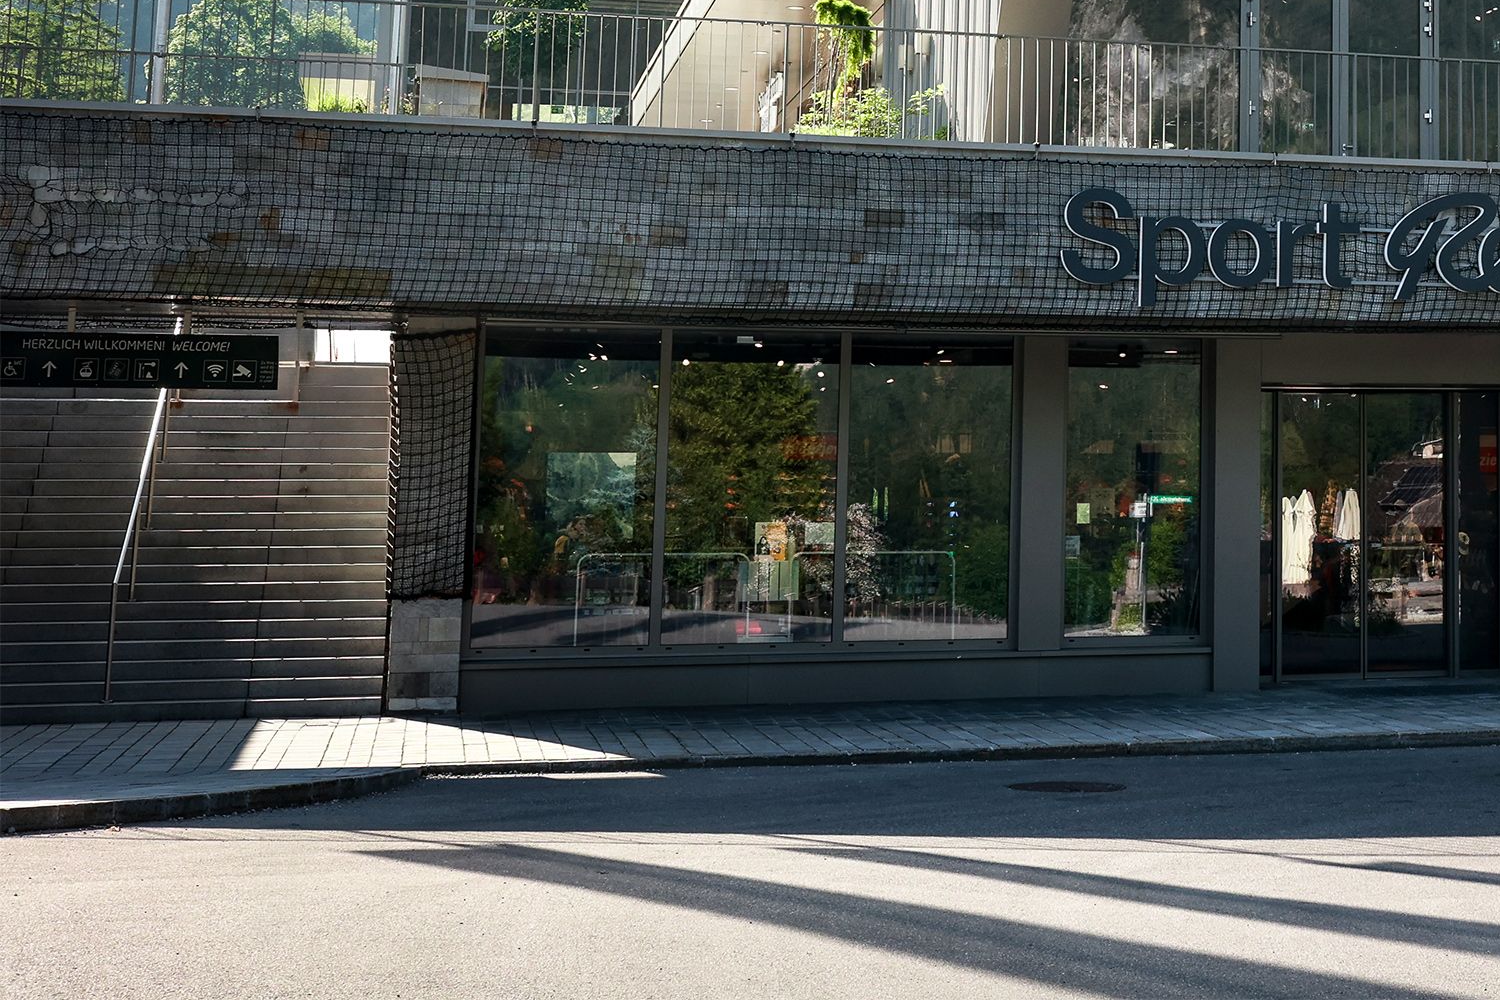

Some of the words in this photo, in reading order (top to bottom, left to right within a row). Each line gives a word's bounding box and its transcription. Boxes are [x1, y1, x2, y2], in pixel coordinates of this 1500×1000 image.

[1059, 187, 1362, 307] Sport
[22, 338, 80, 350] HERZLICH
[84, 340, 166, 352] WILLKOMMEN!
[172, 341, 231, 352] WELCOME!
